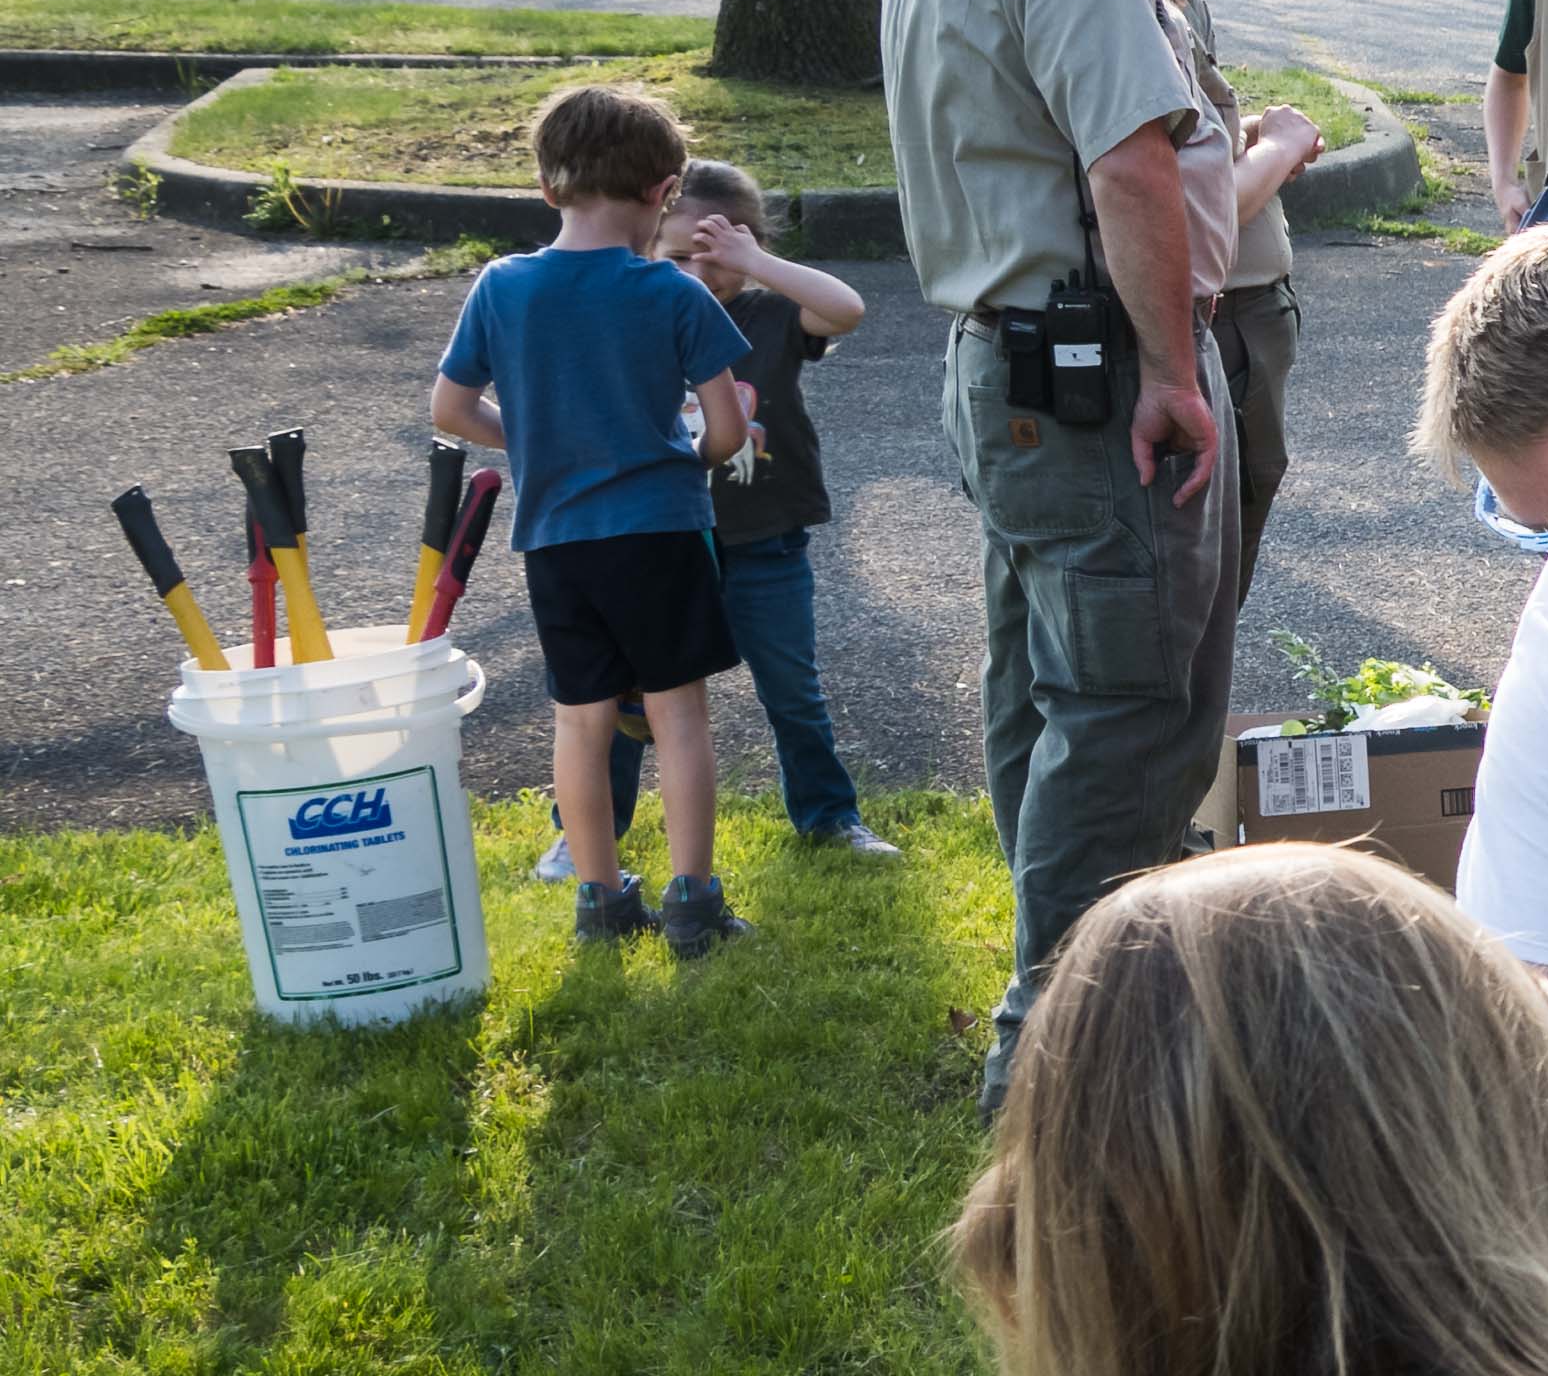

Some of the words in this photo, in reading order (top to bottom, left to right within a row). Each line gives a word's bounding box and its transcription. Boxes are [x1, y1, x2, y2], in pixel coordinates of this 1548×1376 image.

[295, 787, 387, 829] CCH
[284, 839, 360, 856] CHLORINATING
[361, 831, 406, 848] TABLETS
[346, 973, 360, 985] 50
